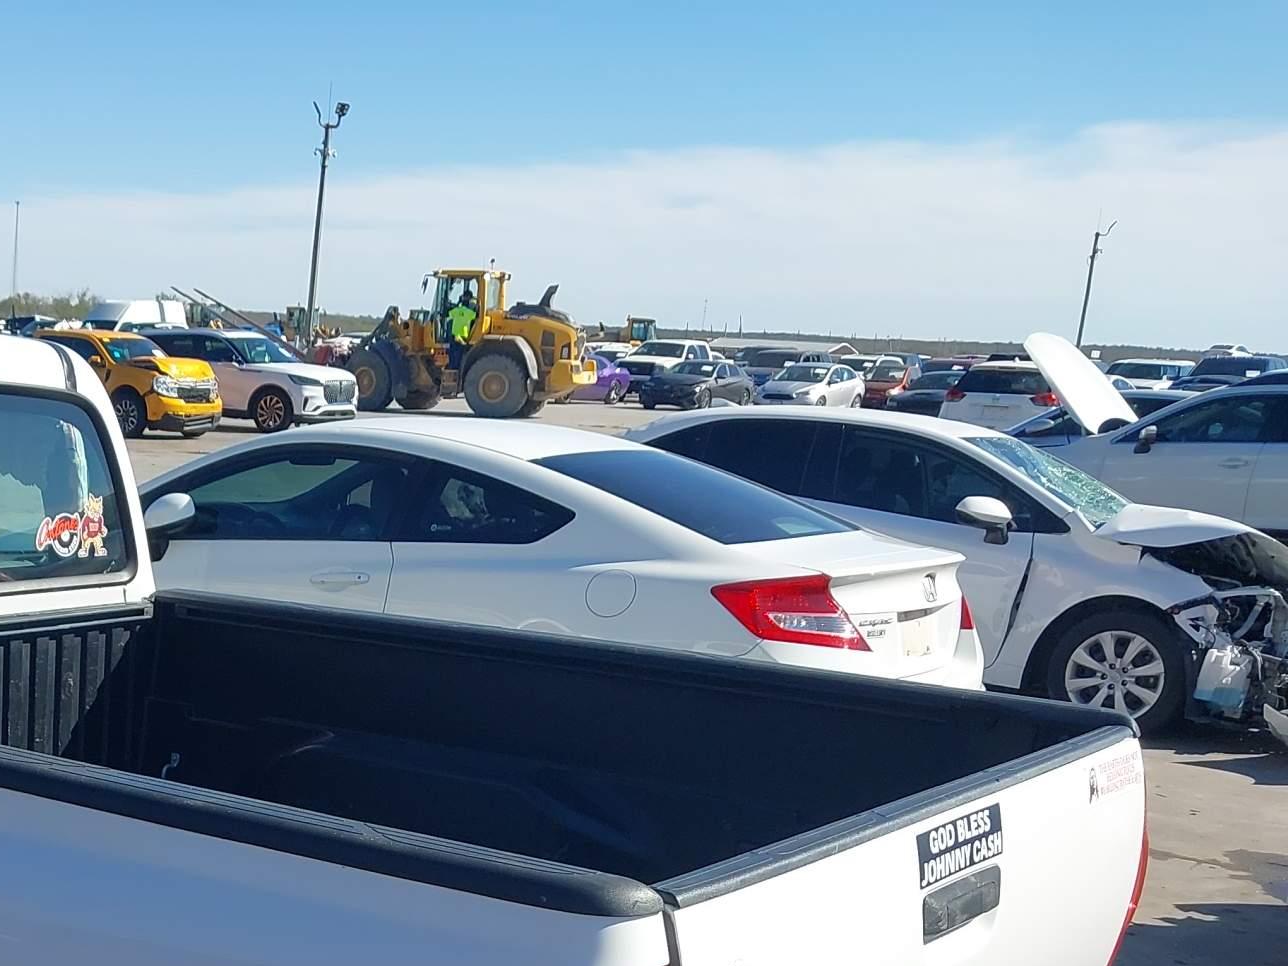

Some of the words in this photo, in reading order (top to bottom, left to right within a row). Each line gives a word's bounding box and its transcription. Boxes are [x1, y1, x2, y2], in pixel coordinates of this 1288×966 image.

[929, 823, 955, 854] GOD
[956, 809, 991, 843] BLESS
[921, 843, 972, 887] JOHNNY
[973, 831, 1002, 863] CASH
